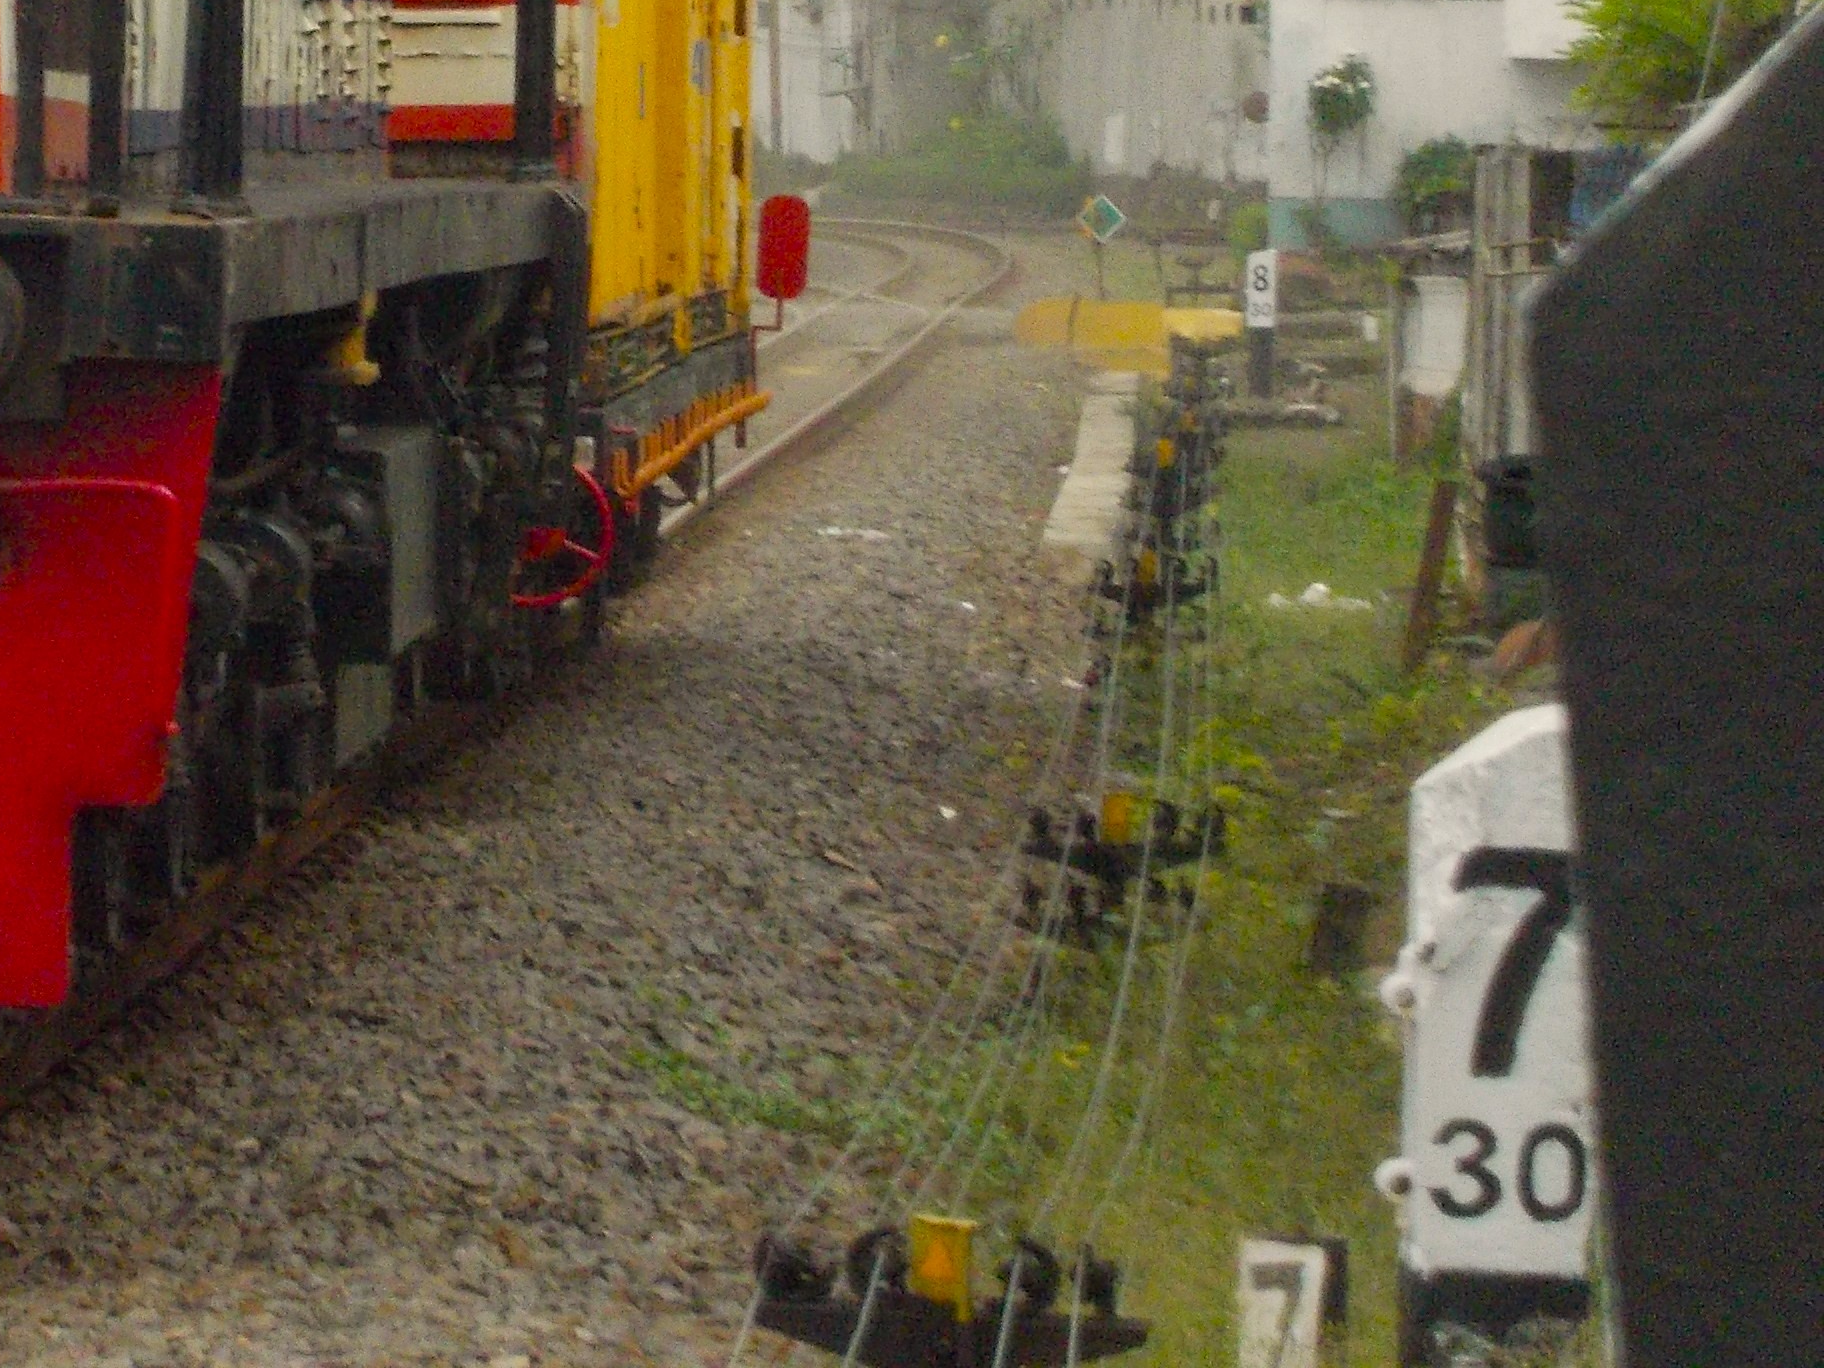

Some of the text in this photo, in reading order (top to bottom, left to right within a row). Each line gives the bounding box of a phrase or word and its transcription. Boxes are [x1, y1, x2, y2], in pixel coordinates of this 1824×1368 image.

[1253, 264, 1269, 292] 8
[1452, 845, 1576, 1078] 7
[1429, 1118, 1588, 1223] 30
